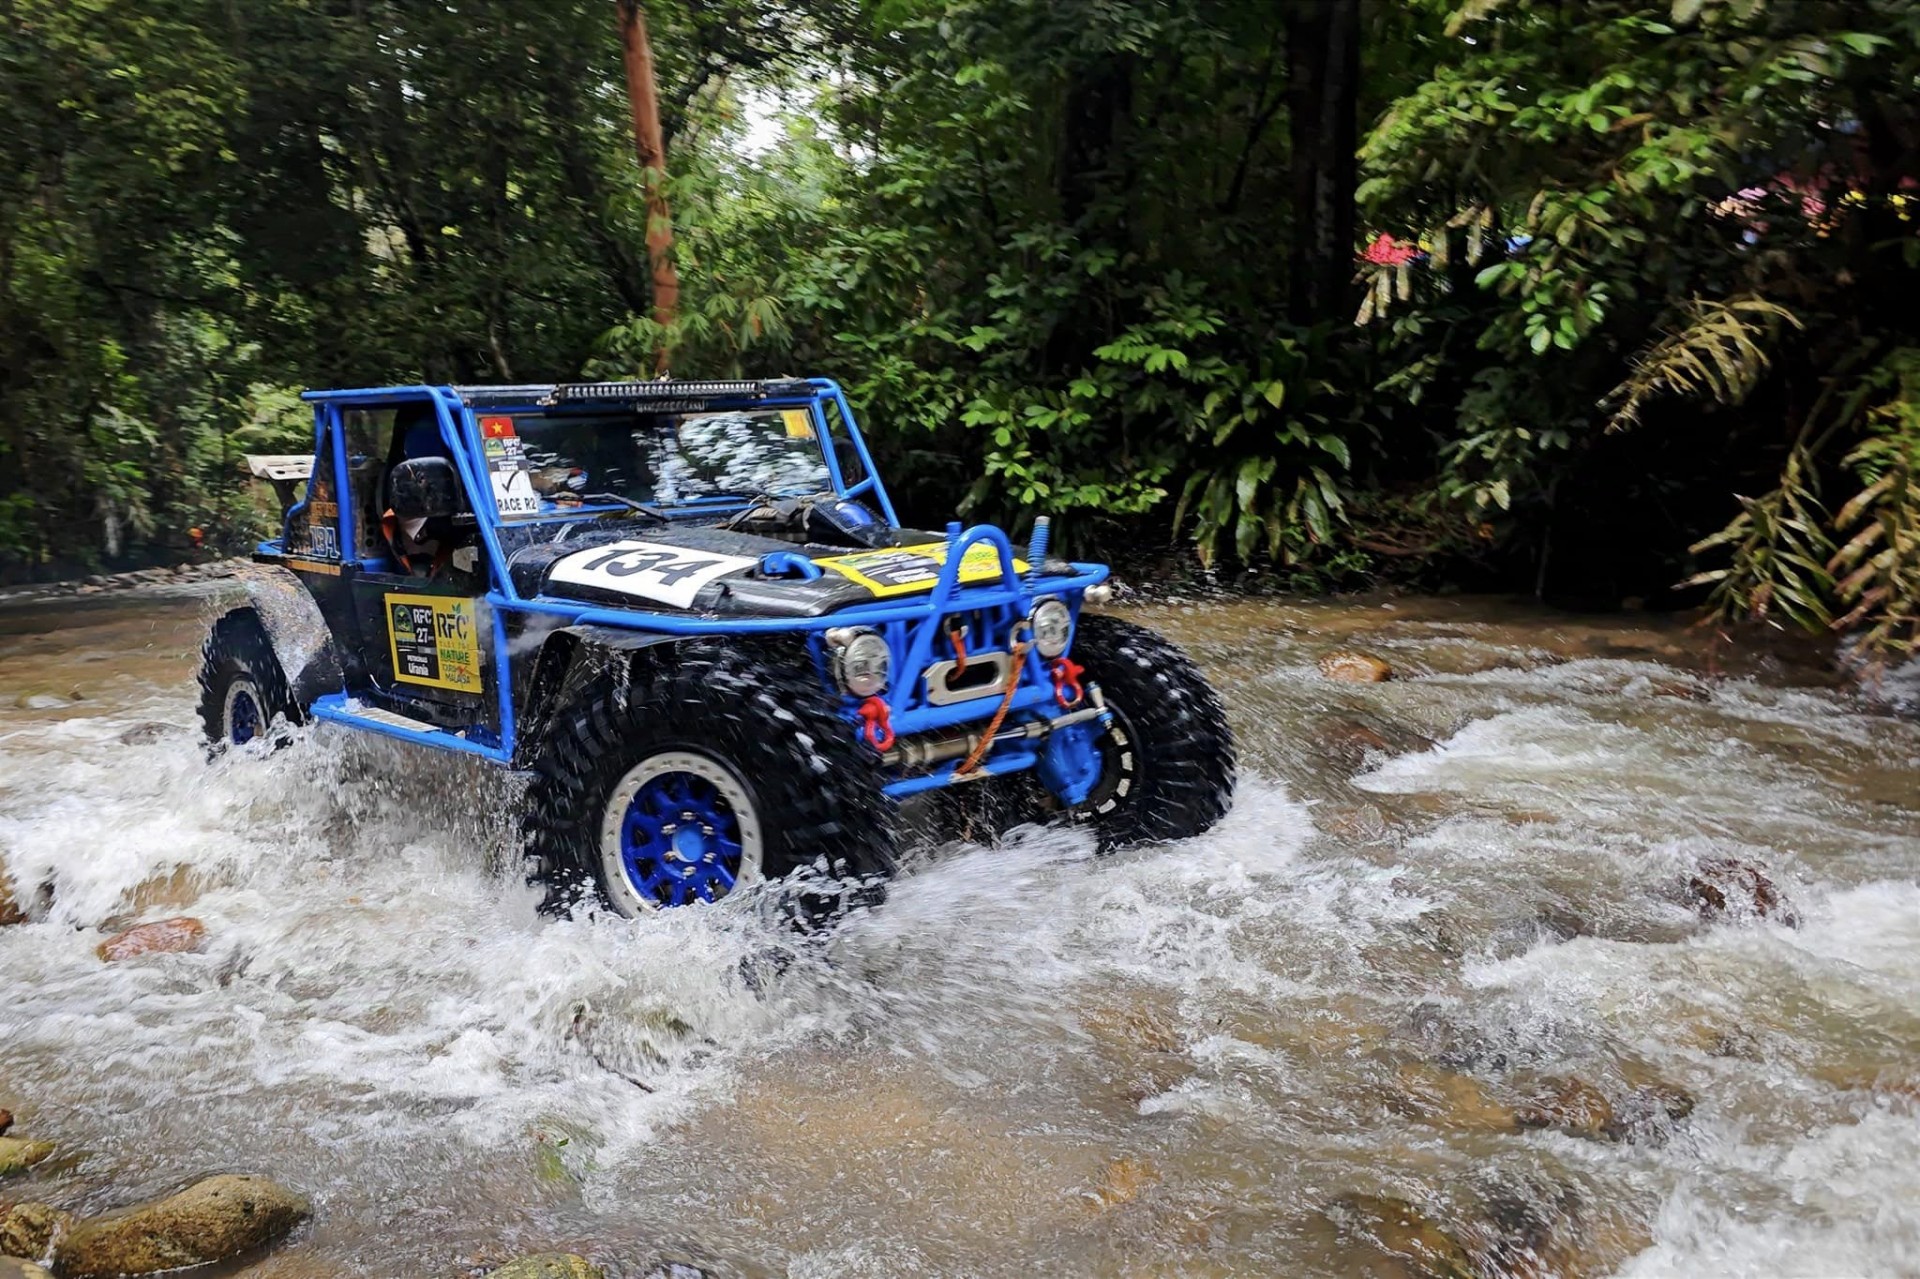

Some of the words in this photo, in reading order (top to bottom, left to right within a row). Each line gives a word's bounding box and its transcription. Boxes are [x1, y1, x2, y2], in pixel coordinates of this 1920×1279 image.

[497, 498, 523, 512] RACE
[524, 497, 537, 511] R2
[582, 549, 724, 586] 134
[413, 608, 432, 624] RFC
[436, 612, 467, 640] RFC
[416, 628, 428, 643] 27
